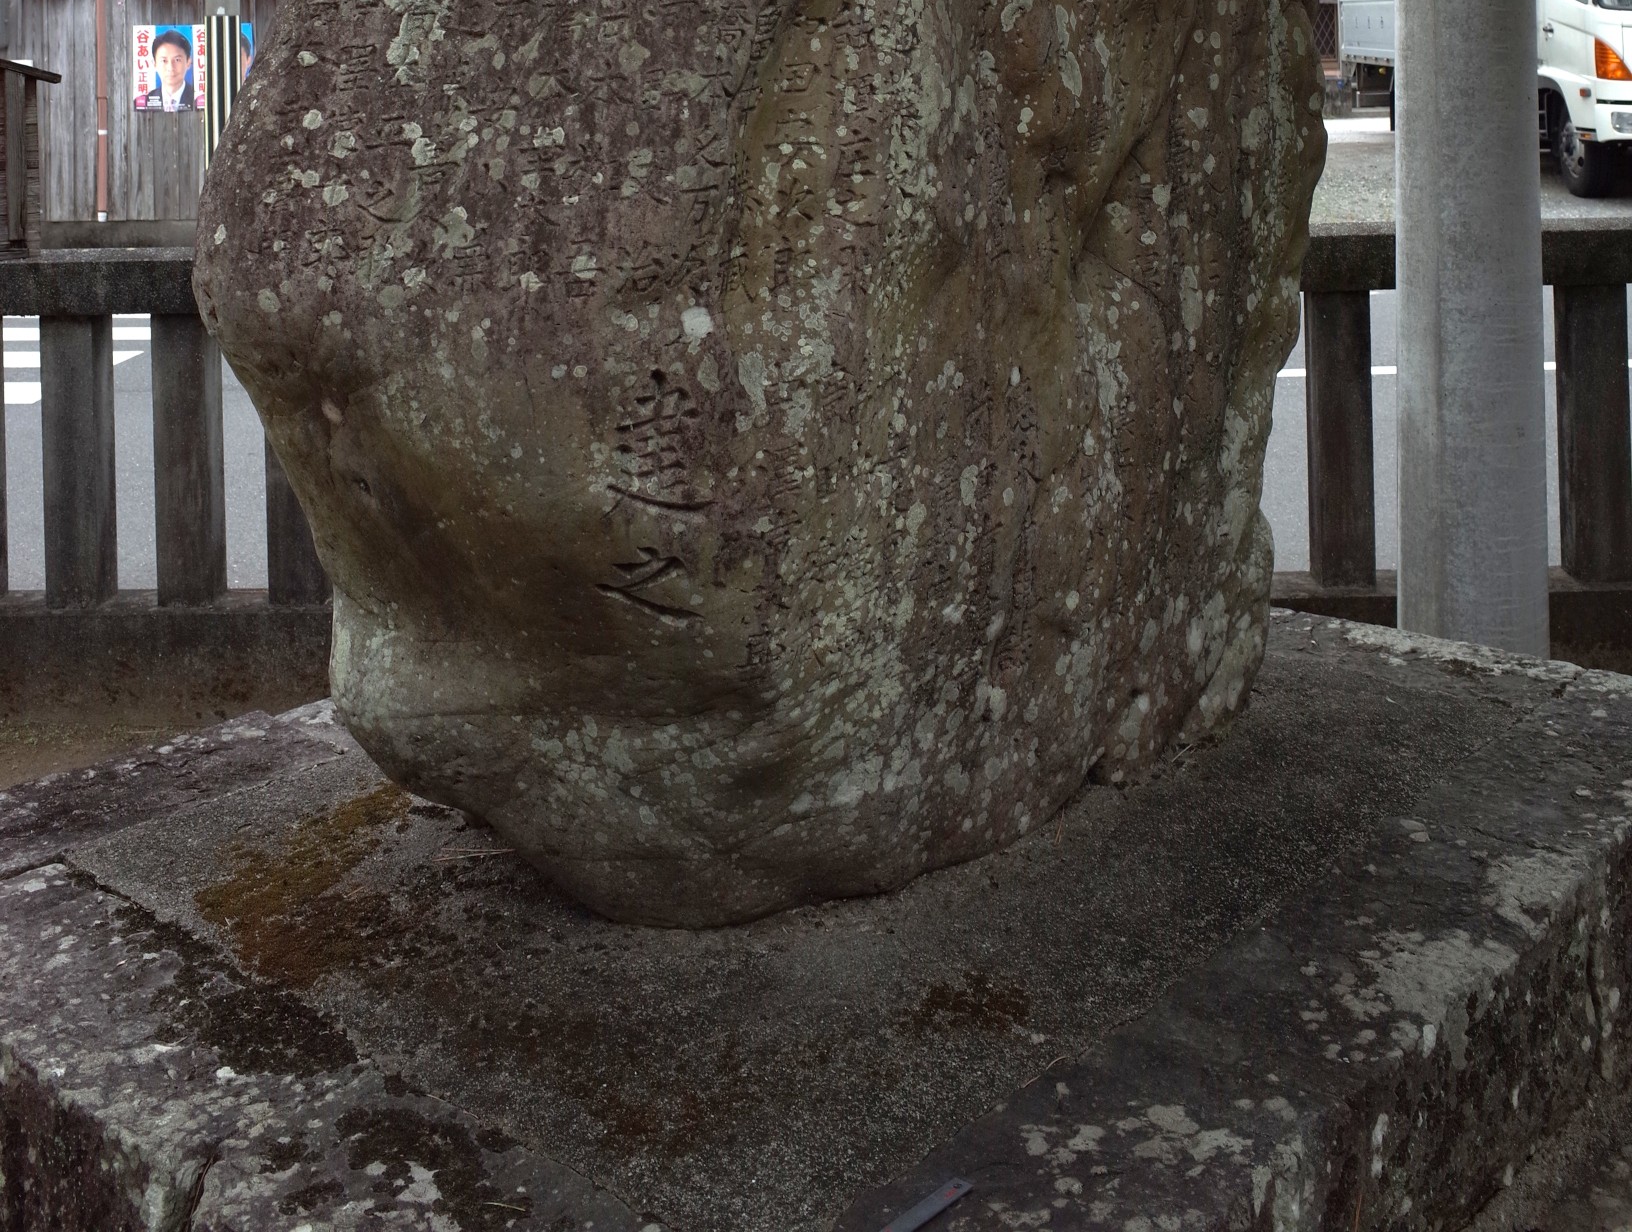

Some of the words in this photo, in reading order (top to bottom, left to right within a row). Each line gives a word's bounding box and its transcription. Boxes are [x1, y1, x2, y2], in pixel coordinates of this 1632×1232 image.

[136, 29, 149, 94] 谷あい正明
